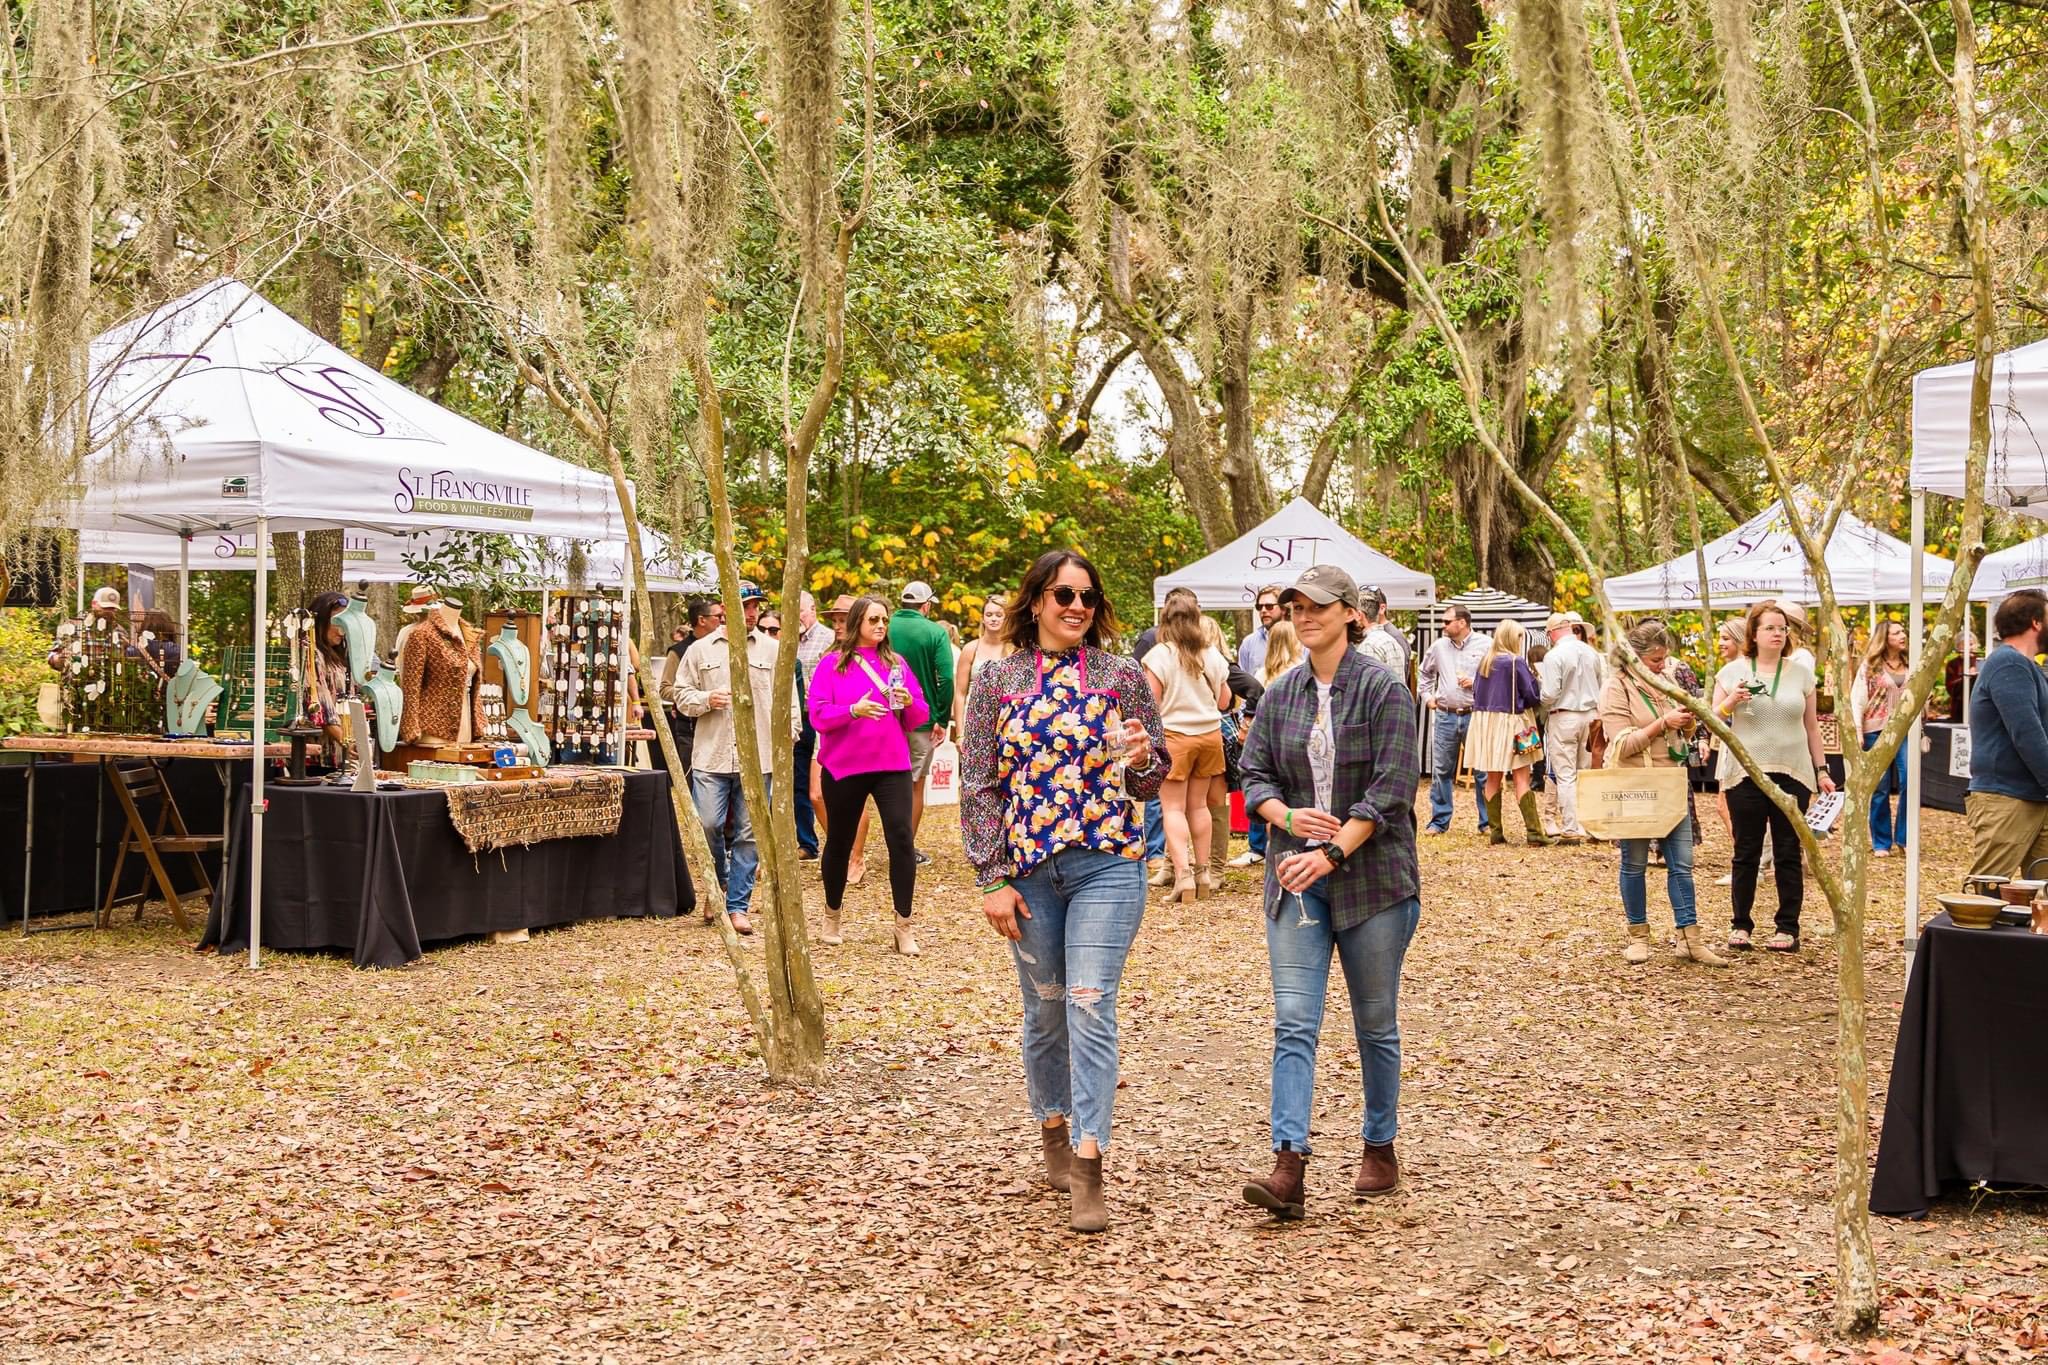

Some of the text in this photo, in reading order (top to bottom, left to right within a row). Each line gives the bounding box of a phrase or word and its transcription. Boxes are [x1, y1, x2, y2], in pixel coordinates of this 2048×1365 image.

[431, 470, 532, 506] FRANCISVILLE
[418, 500, 527, 520] FOOD & WINE FESTIVAL
